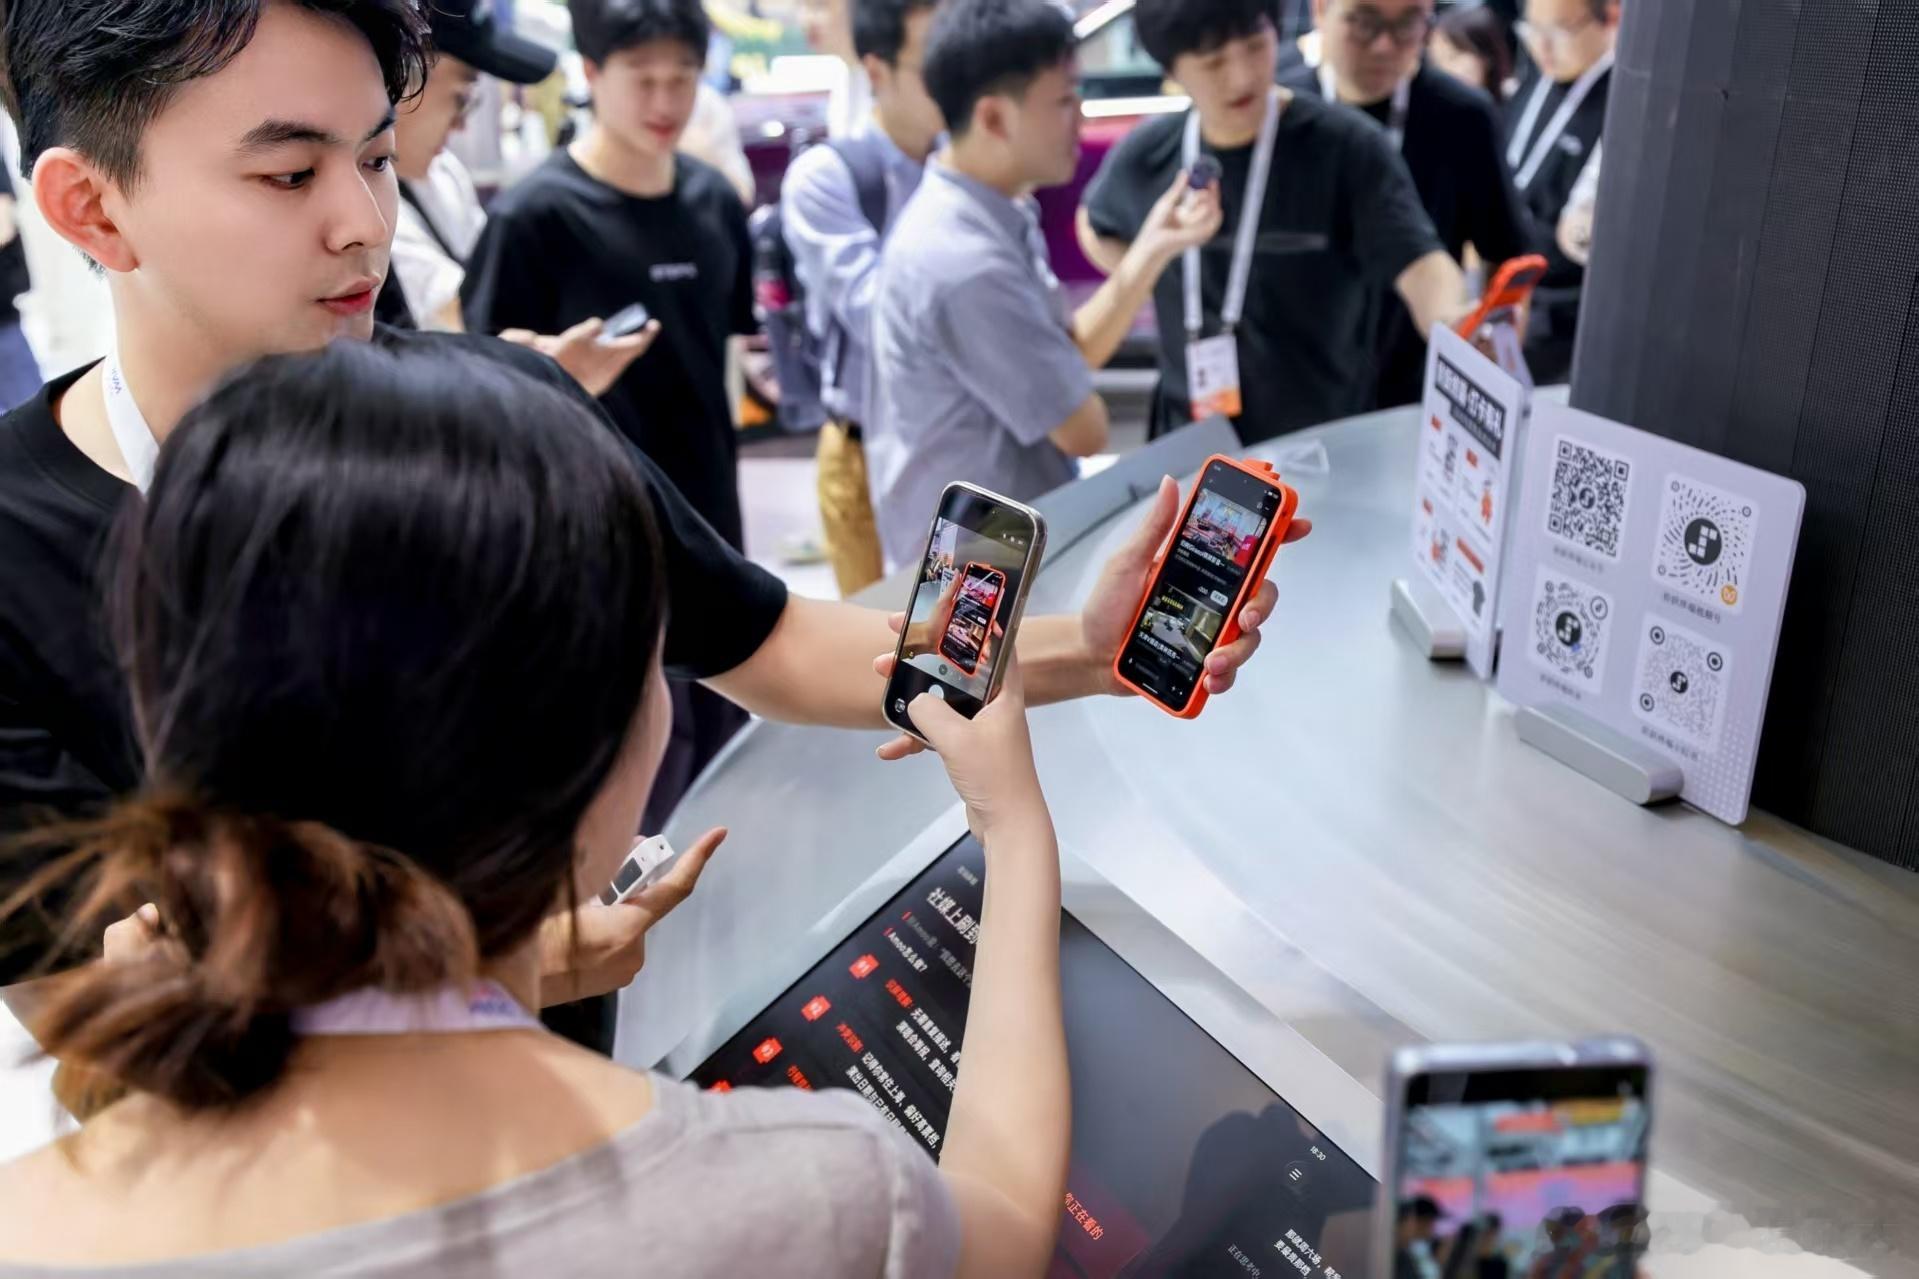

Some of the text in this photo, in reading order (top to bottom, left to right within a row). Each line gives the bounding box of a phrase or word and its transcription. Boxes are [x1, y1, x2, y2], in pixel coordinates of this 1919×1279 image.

[910, 1007, 961, 1067] 无需重复描述，看
[1310, 1145, 1327, 1160] 18:30
